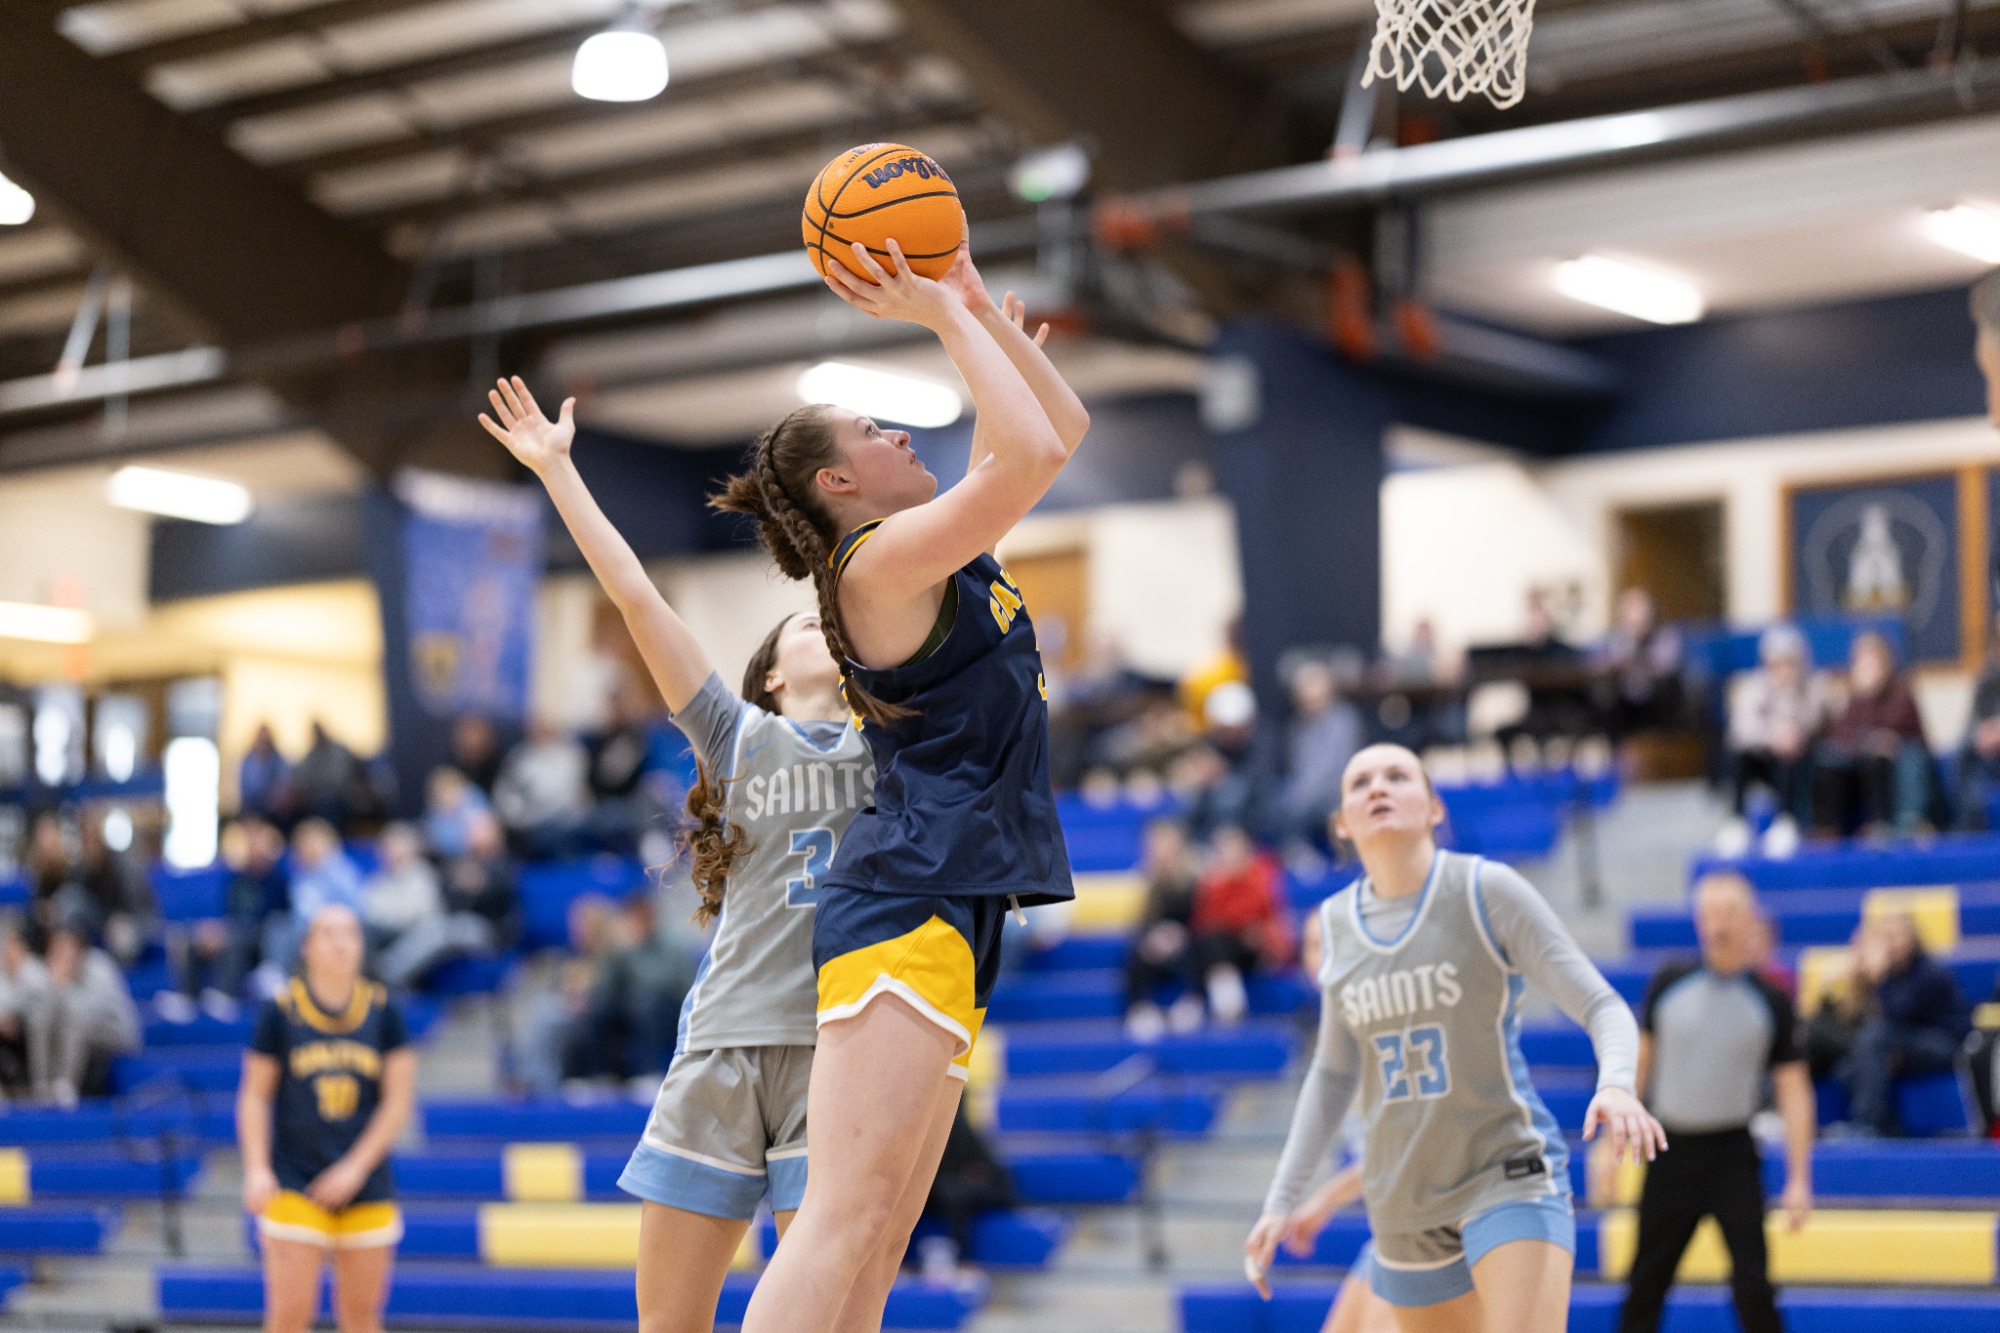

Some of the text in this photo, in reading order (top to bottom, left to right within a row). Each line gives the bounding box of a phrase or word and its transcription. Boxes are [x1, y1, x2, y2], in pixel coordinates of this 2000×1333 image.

[745, 762, 877, 822] SAINTS
[785, 826, 836, 909] 3
[1341, 961, 1464, 1027] SAINTS
[1370, 1022, 1453, 1104] 23
